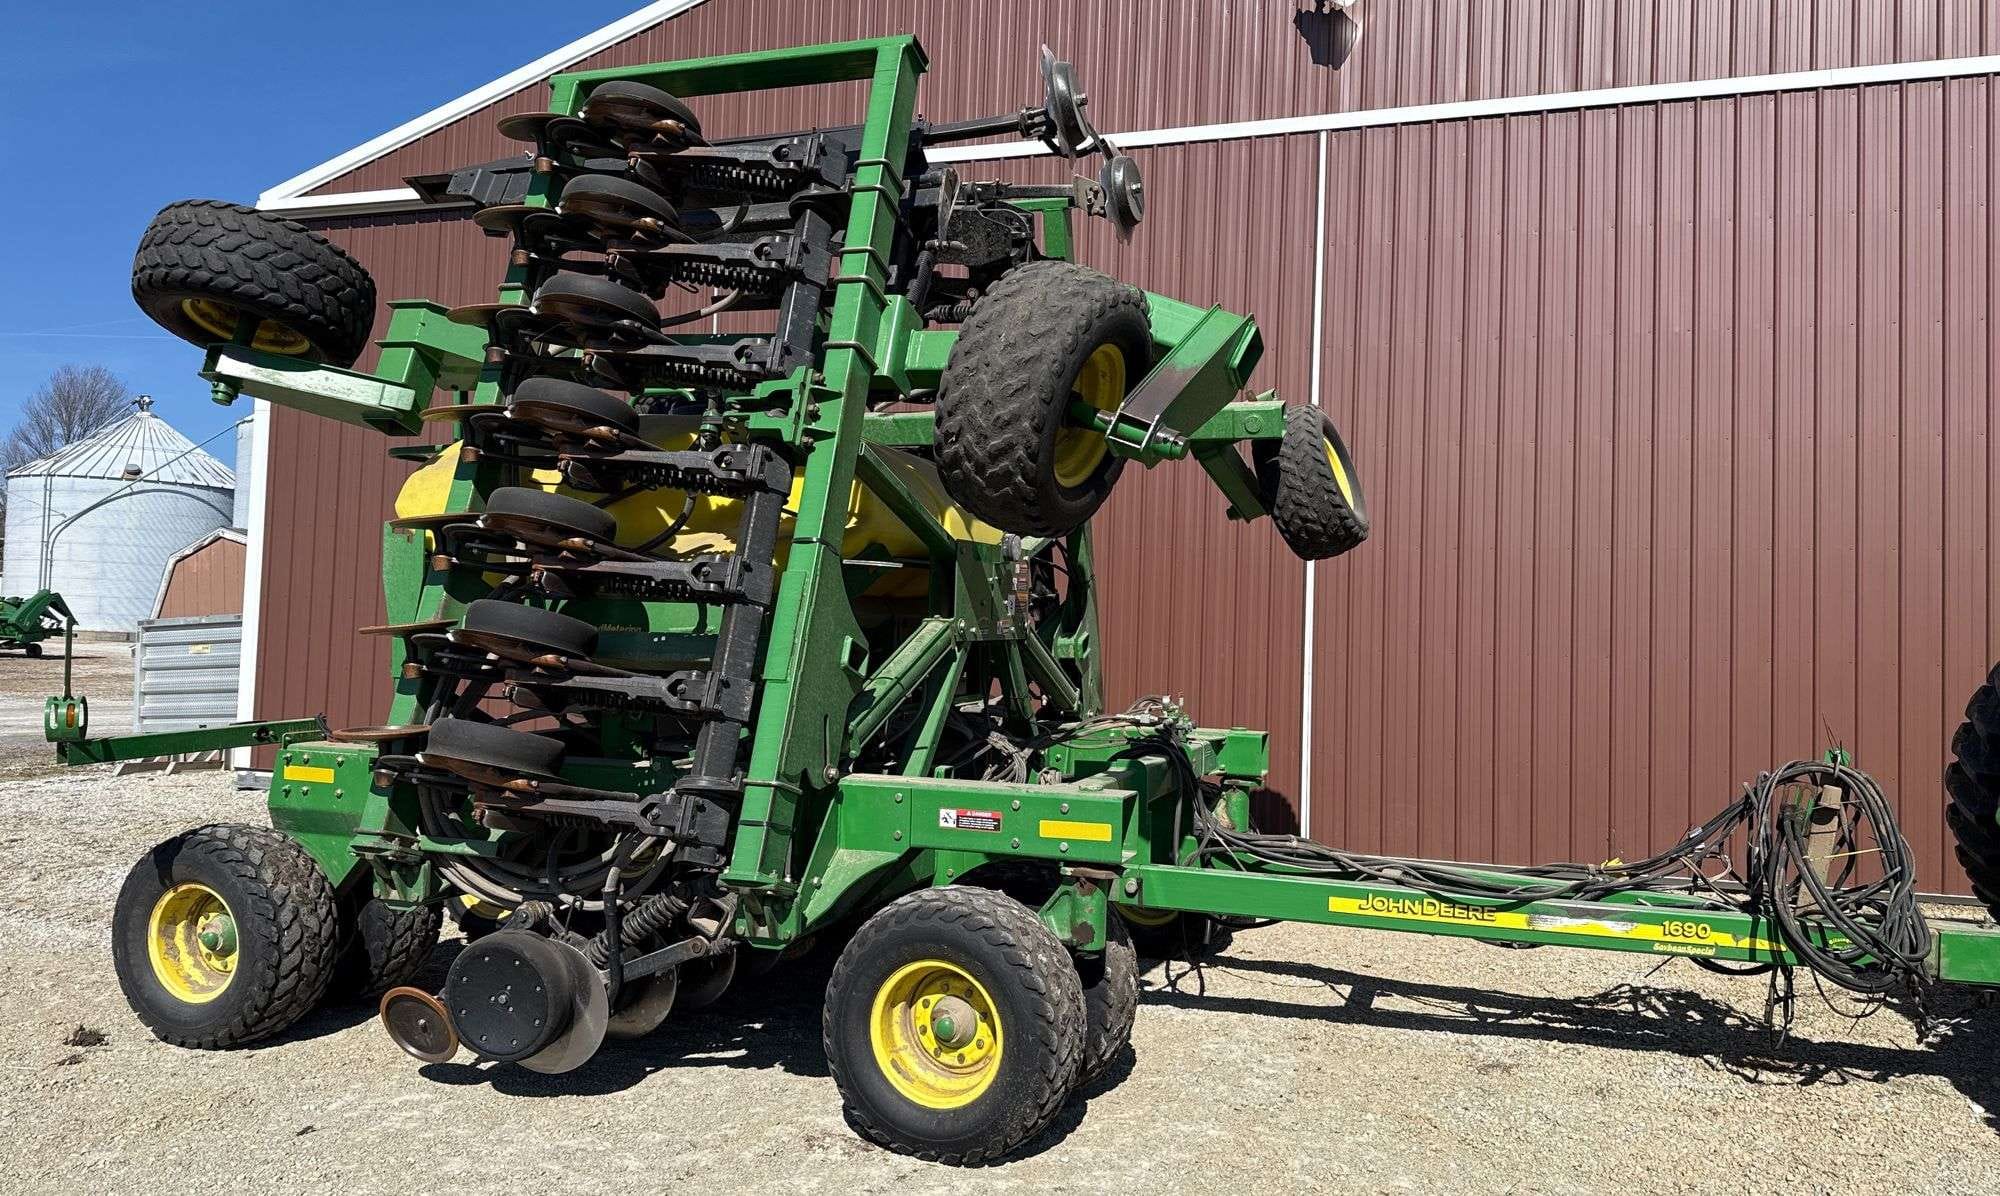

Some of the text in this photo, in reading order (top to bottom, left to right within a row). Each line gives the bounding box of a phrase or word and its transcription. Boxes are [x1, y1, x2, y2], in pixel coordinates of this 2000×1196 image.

[1358, 893, 1497, 921] JOHN DEERE
[1662, 920, 1711, 939] 1690
